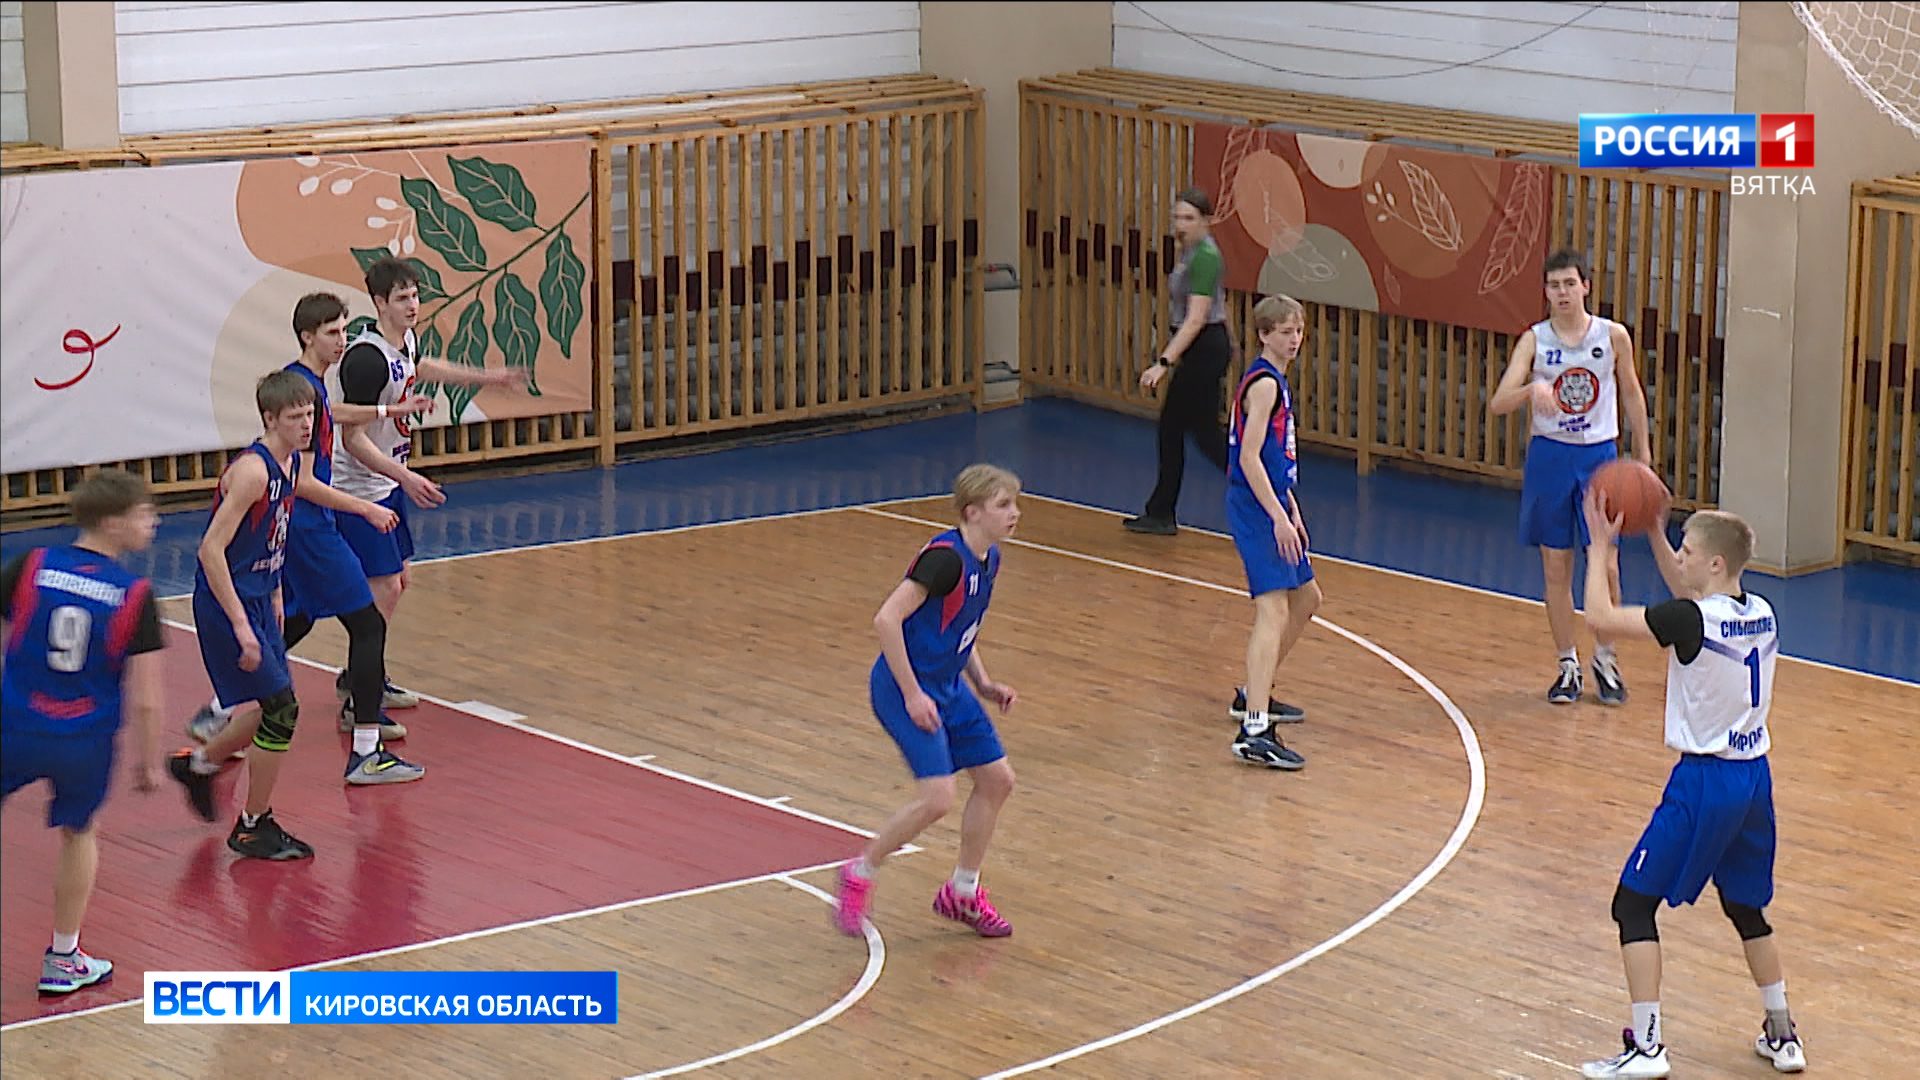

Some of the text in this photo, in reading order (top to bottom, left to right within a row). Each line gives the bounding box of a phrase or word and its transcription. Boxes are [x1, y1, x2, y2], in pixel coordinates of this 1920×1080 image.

[1546, 349, 1563, 366] 22
[269, 479, 282, 502] 21
[47, 605, 92, 672] 9
[1744, 647, 1760, 708] 1
[1636, 848, 1648, 870] 1
